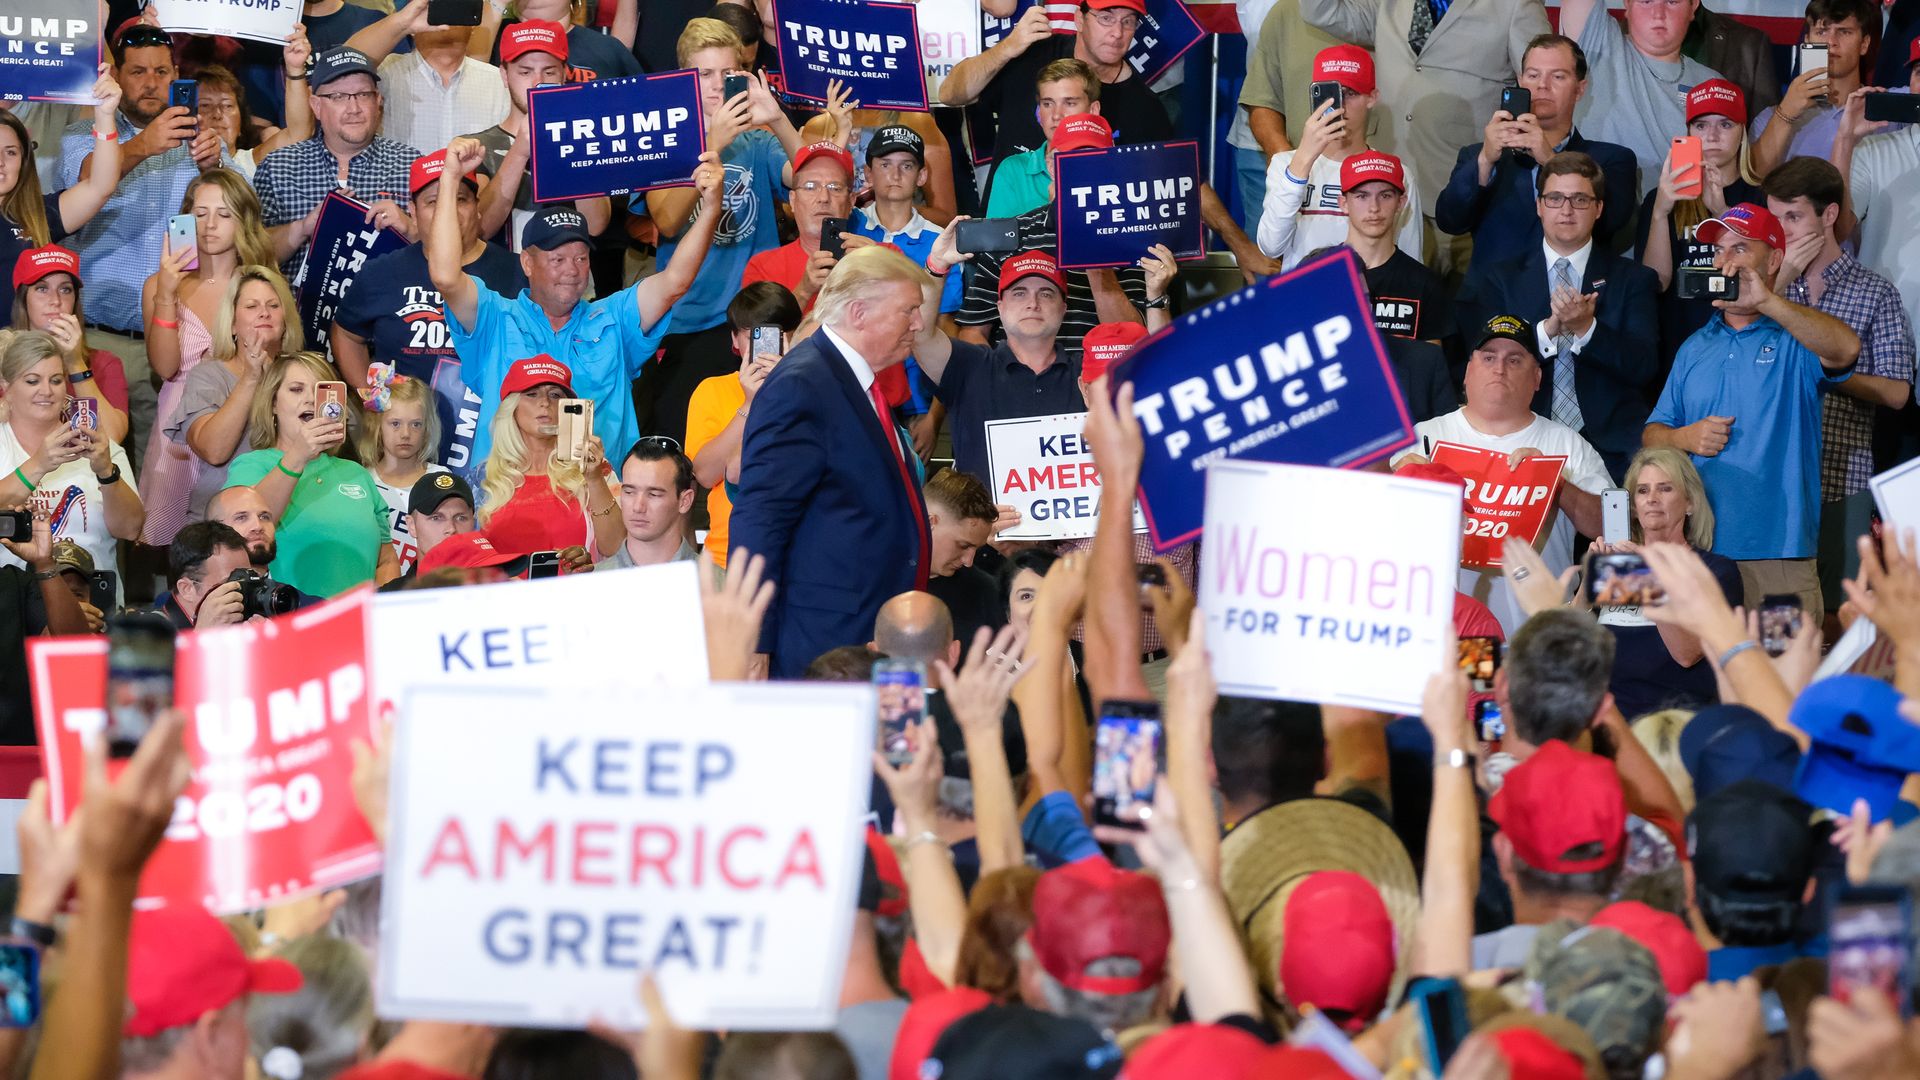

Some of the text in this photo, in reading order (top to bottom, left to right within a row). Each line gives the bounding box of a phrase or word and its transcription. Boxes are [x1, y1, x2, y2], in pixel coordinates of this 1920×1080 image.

[0, 16, 88, 38] UMP
[785, 20, 907, 54] TRUMP
[8, 40, 75, 55] NCE
[798, 45, 898, 70] PENCE
[807, 63, 826, 72] KEEP
[827, 68, 860, 78] AMERICA
[545, 107, 689, 142] TRUMP
[882, 127, 920, 143] TRUMP
[560, 133, 678, 158] PENCE
[571, 152, 668, 168] KEEP AMERICA GREAT!
[610, 188, 629, 196] 2020
[1071, 176, 1193, 208] TRUMP
[543, 212, 582, 222] TRUMP
[1085, 202, 1187, 224] PENCE
[1096, 221, 1181, 235] KEEP AMERICA GREAT!
[331, 238, 341, 263] KEEP
[316, 231, 356, 345] PENCE
[319, 260, 333, 297] AMERICA
[403, 286, 445, 305] Tru
[1132, 315, 1352, 436] TRUMP
[1164, 362, 1348, 460] PENCE
[1228, 421, 1291, 457] AMERICA
[1003, 462, 1102, 494] AMER
[1463, 478, 1549, 506] RUMP
[1464, 518, 1509, 539] 020
[1216, 522, 1435, 617] Women
[1225, 607, 1413, 648] FOR TRUMP
[438, 623, 551, 673] KEE
[63, 661, 365, 755] TUMP
[534, 735, 738, 797] KEEP
[418, 814, 827, 891] AMERICA
[481, 906, 768, 976] GREAT!
